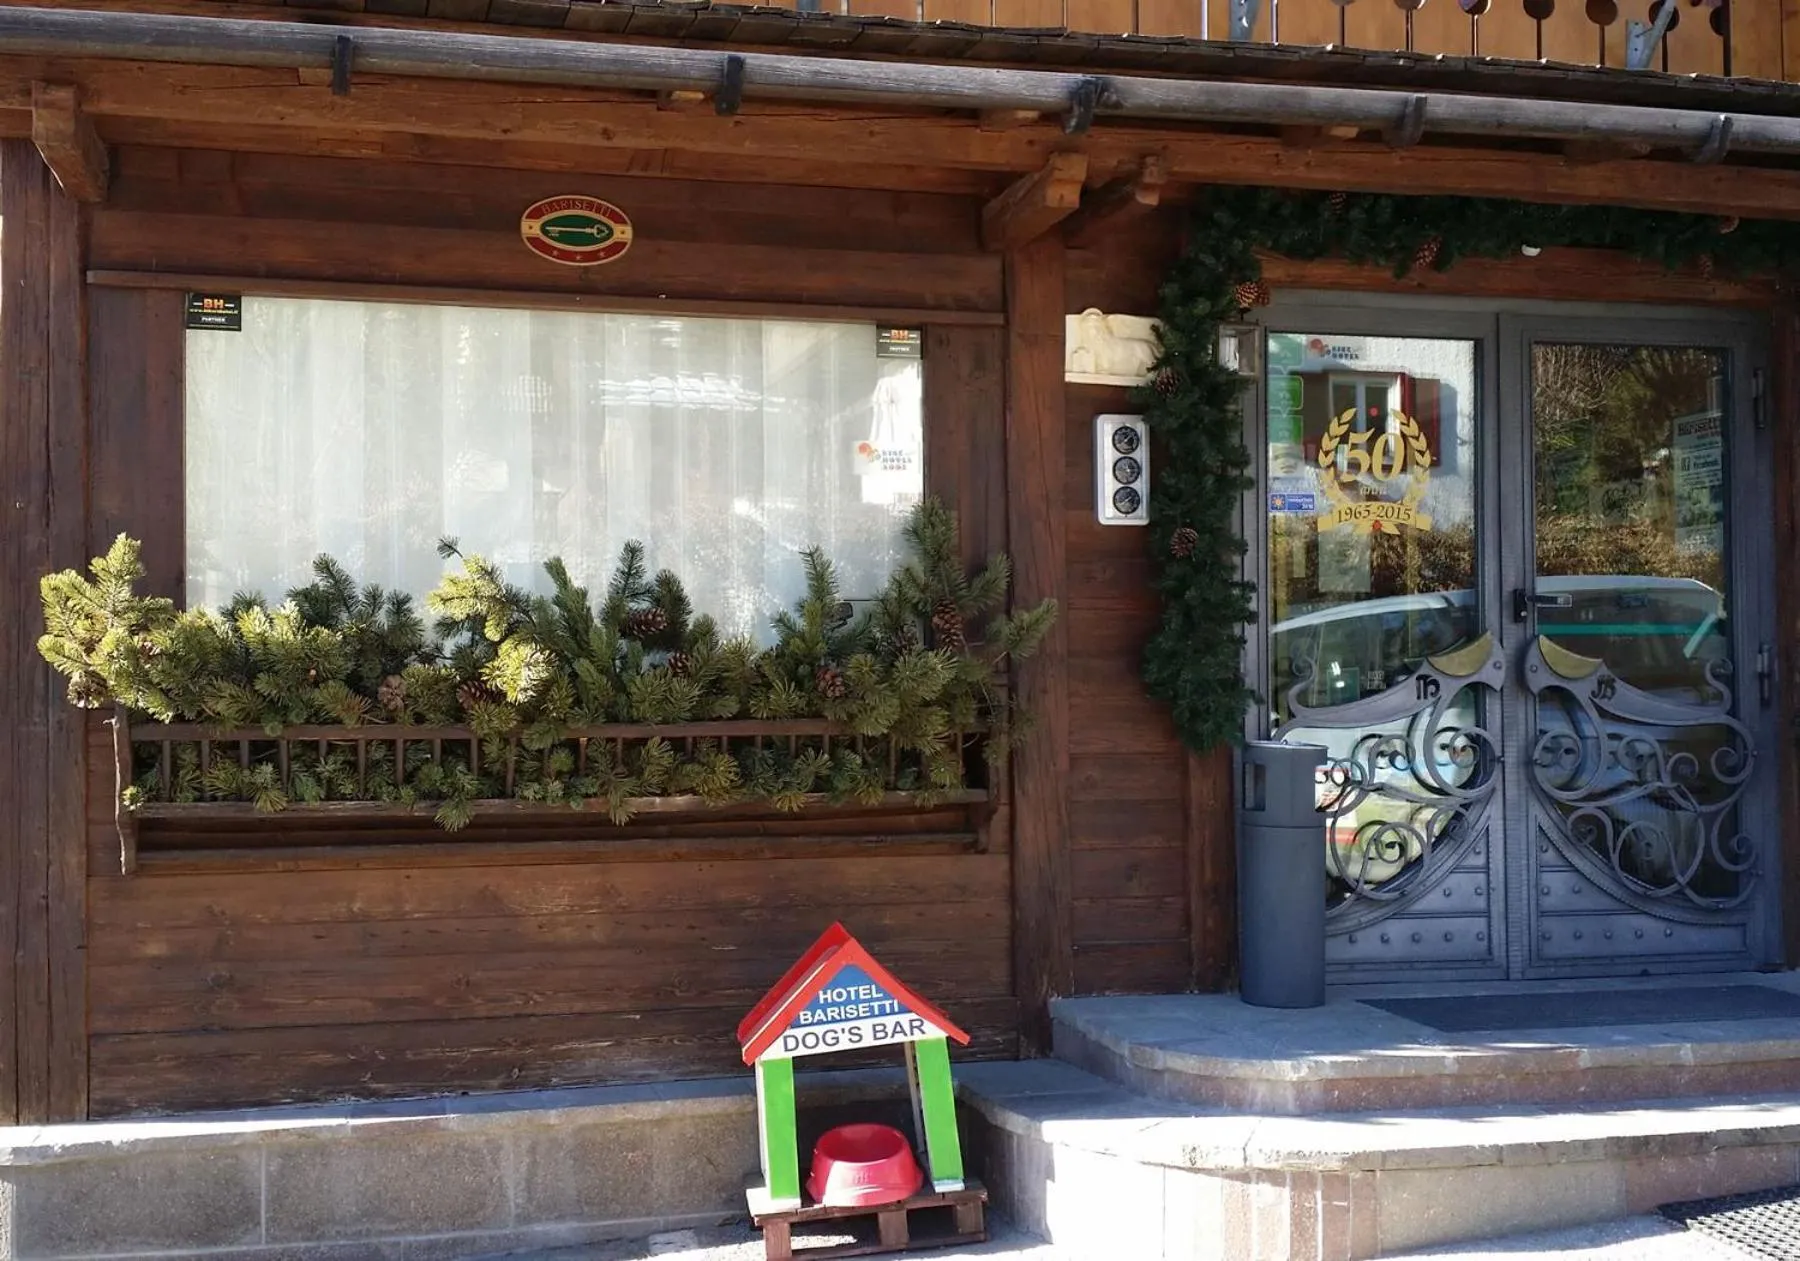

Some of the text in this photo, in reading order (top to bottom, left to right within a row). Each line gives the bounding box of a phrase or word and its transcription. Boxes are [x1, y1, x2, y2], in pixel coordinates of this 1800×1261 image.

[541, 200, 612, 217] BARISETTI
[1340, 427, 1405, 482] 50
[1337, 503, 1413, 523] 1965-2015
[818, 984, 883, 1004] HOTEL
[799, 999, 900, 1025] BARISETTI
[782, 1018, 926, 1052] DOG'S BAR
